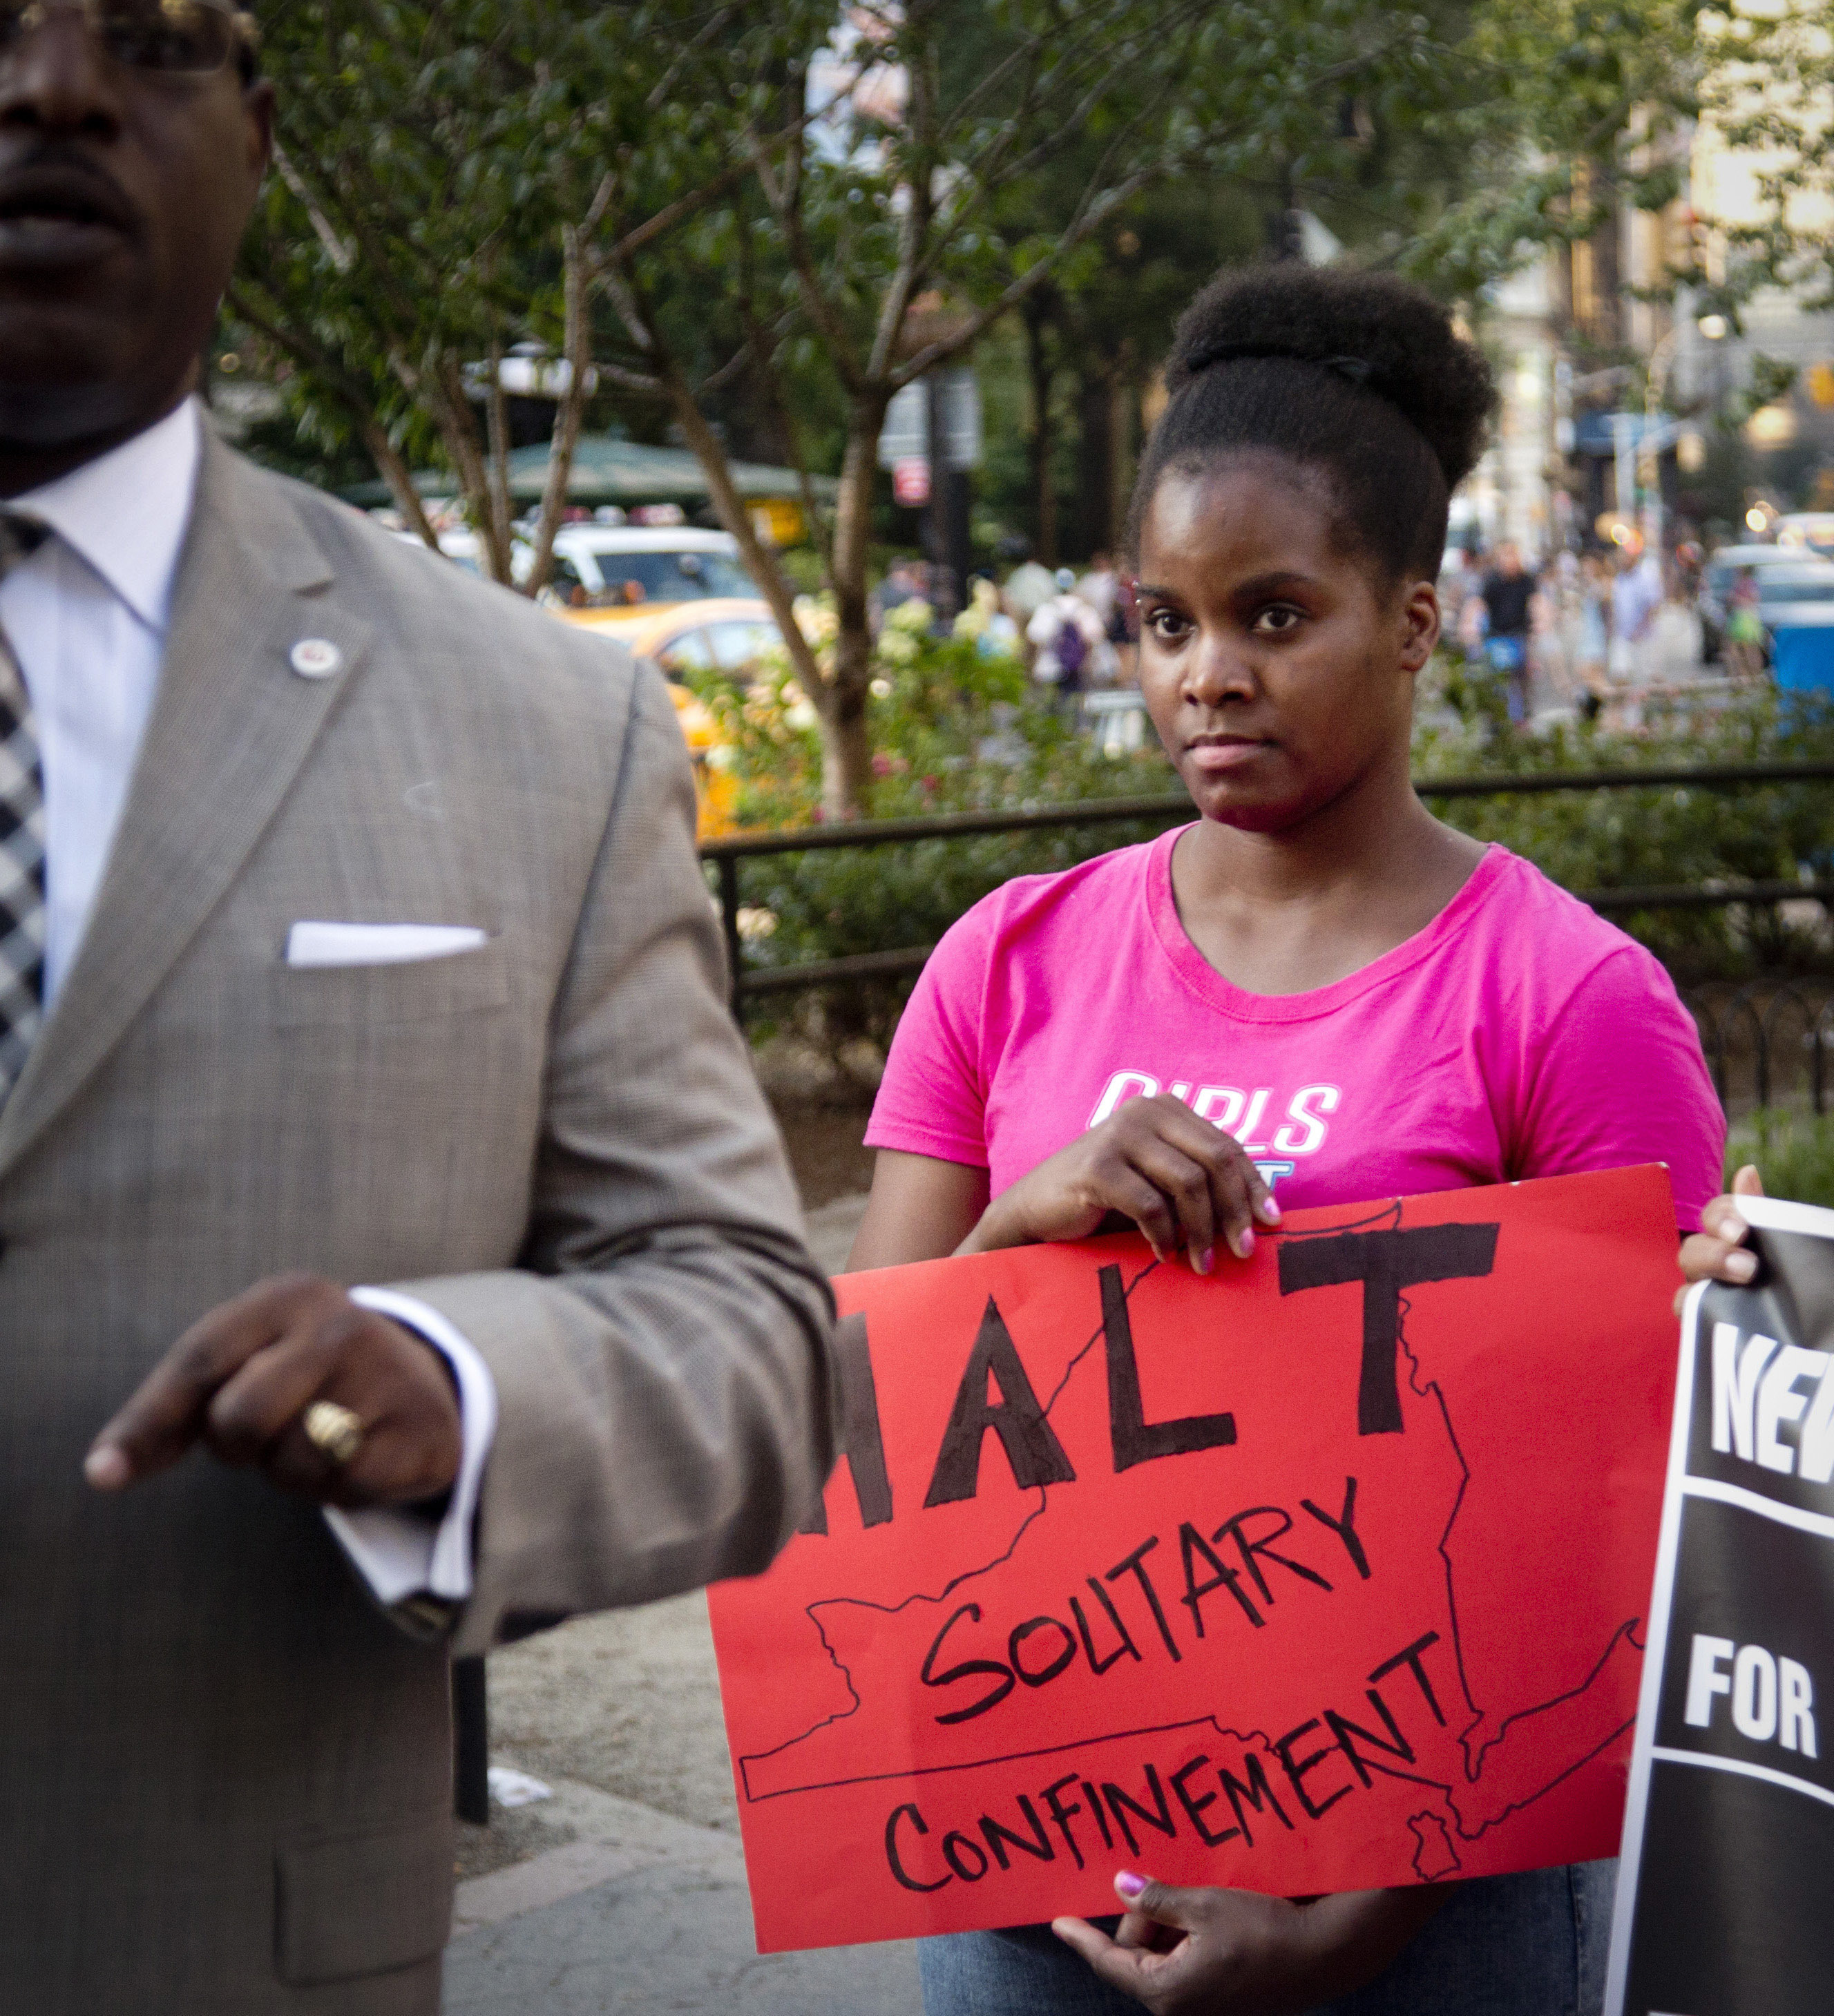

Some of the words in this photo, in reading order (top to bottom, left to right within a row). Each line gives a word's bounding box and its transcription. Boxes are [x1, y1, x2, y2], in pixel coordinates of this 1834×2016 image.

[1087, 1069, 1341, 1155] GRLS
[920, 1476, 1371, 1725] SOLITARY
[884, 1631, 1447, 1892] CONFINEMENT
[1684, 1633, 1818, 1759] FOR
